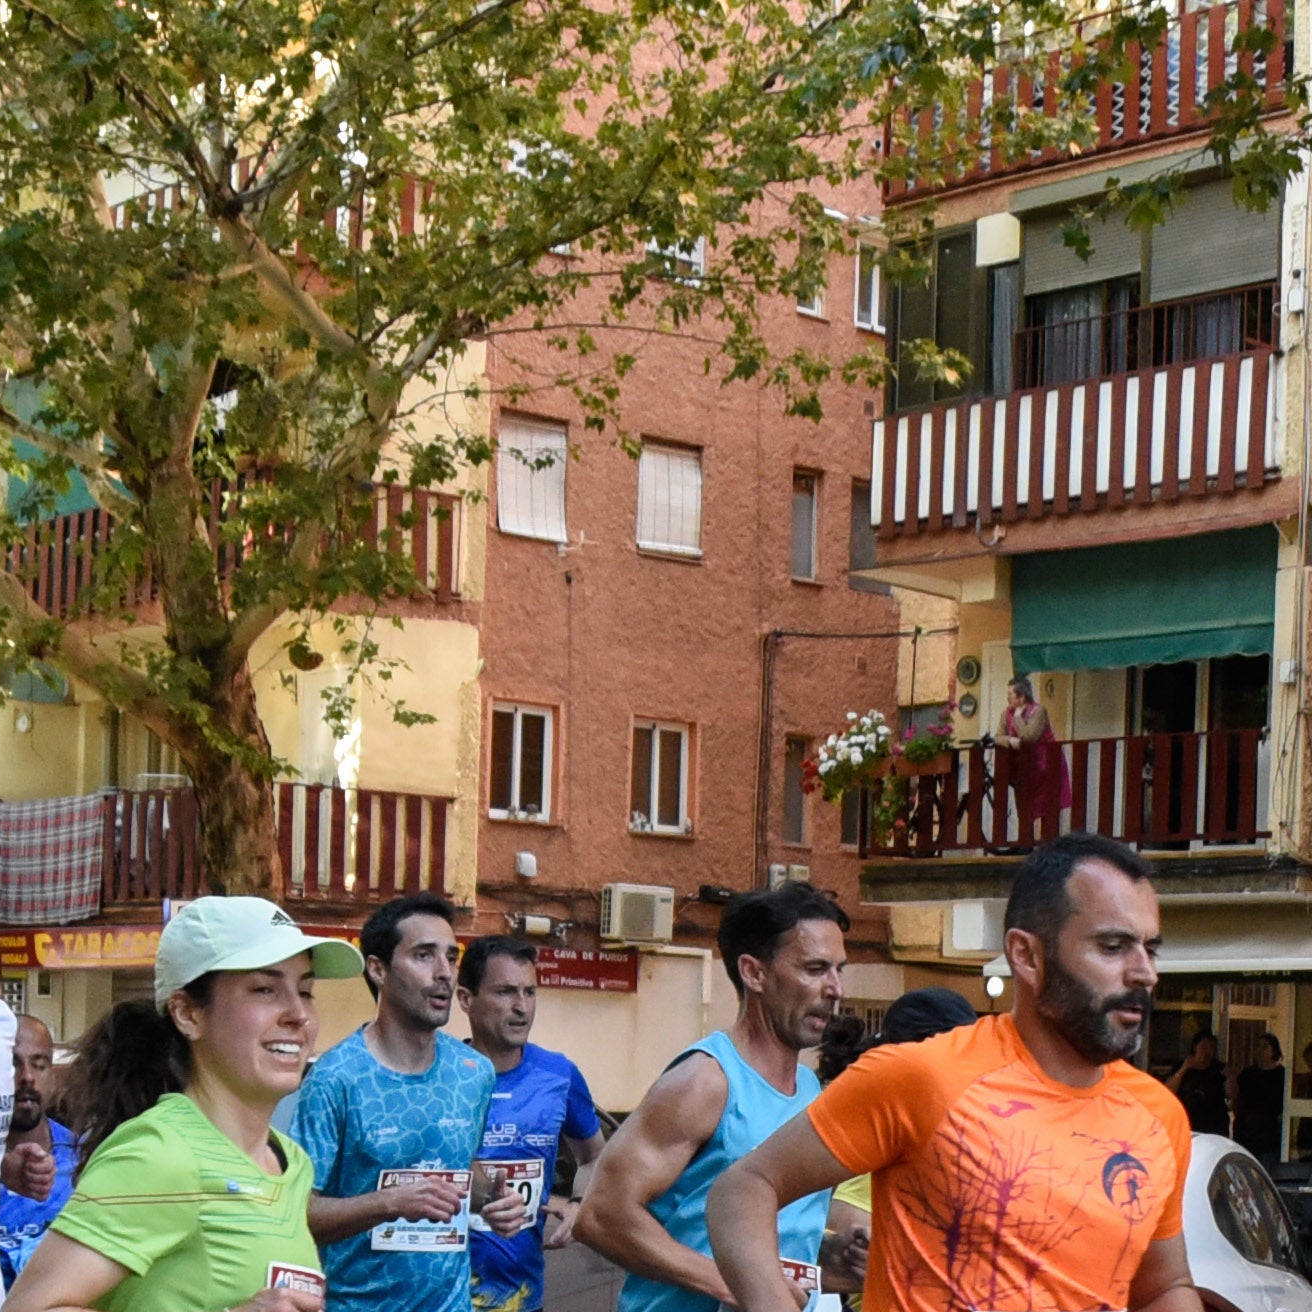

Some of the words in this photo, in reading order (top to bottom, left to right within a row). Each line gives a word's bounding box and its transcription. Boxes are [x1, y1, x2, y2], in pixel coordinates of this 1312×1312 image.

[553, 950, 577, 960] CAVA
[582, 952, 594, 961] DE
[599, 952, 628, 963] PUROS
[560, 976, 594, 987] Primitiva
